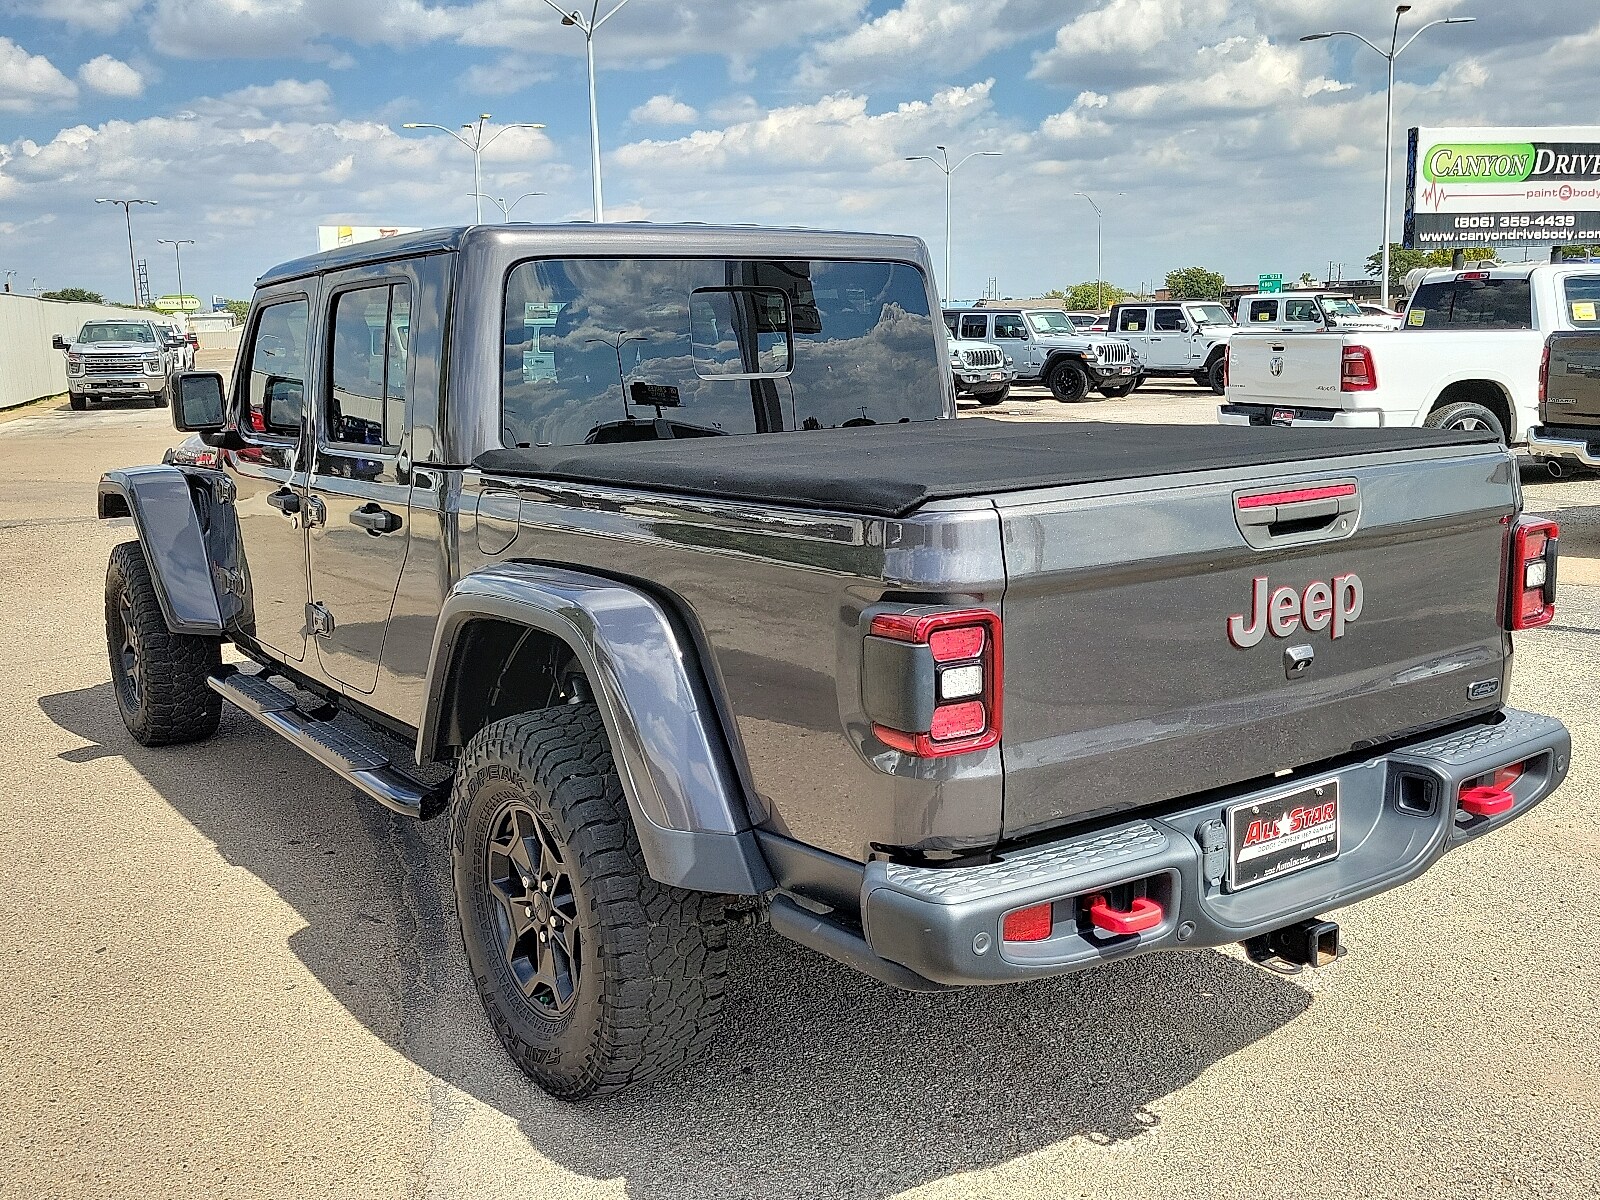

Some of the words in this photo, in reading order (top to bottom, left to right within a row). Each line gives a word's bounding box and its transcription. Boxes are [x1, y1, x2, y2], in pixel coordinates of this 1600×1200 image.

[1430, 149, 1529, 177] CANYON
[1526, 188, 1558, 199] paint
[1454, 216, 1495, 228] (806)
[1499, 215, 1576, 228] 359-4439
[1227, 573, 1364, 649] Jeep
